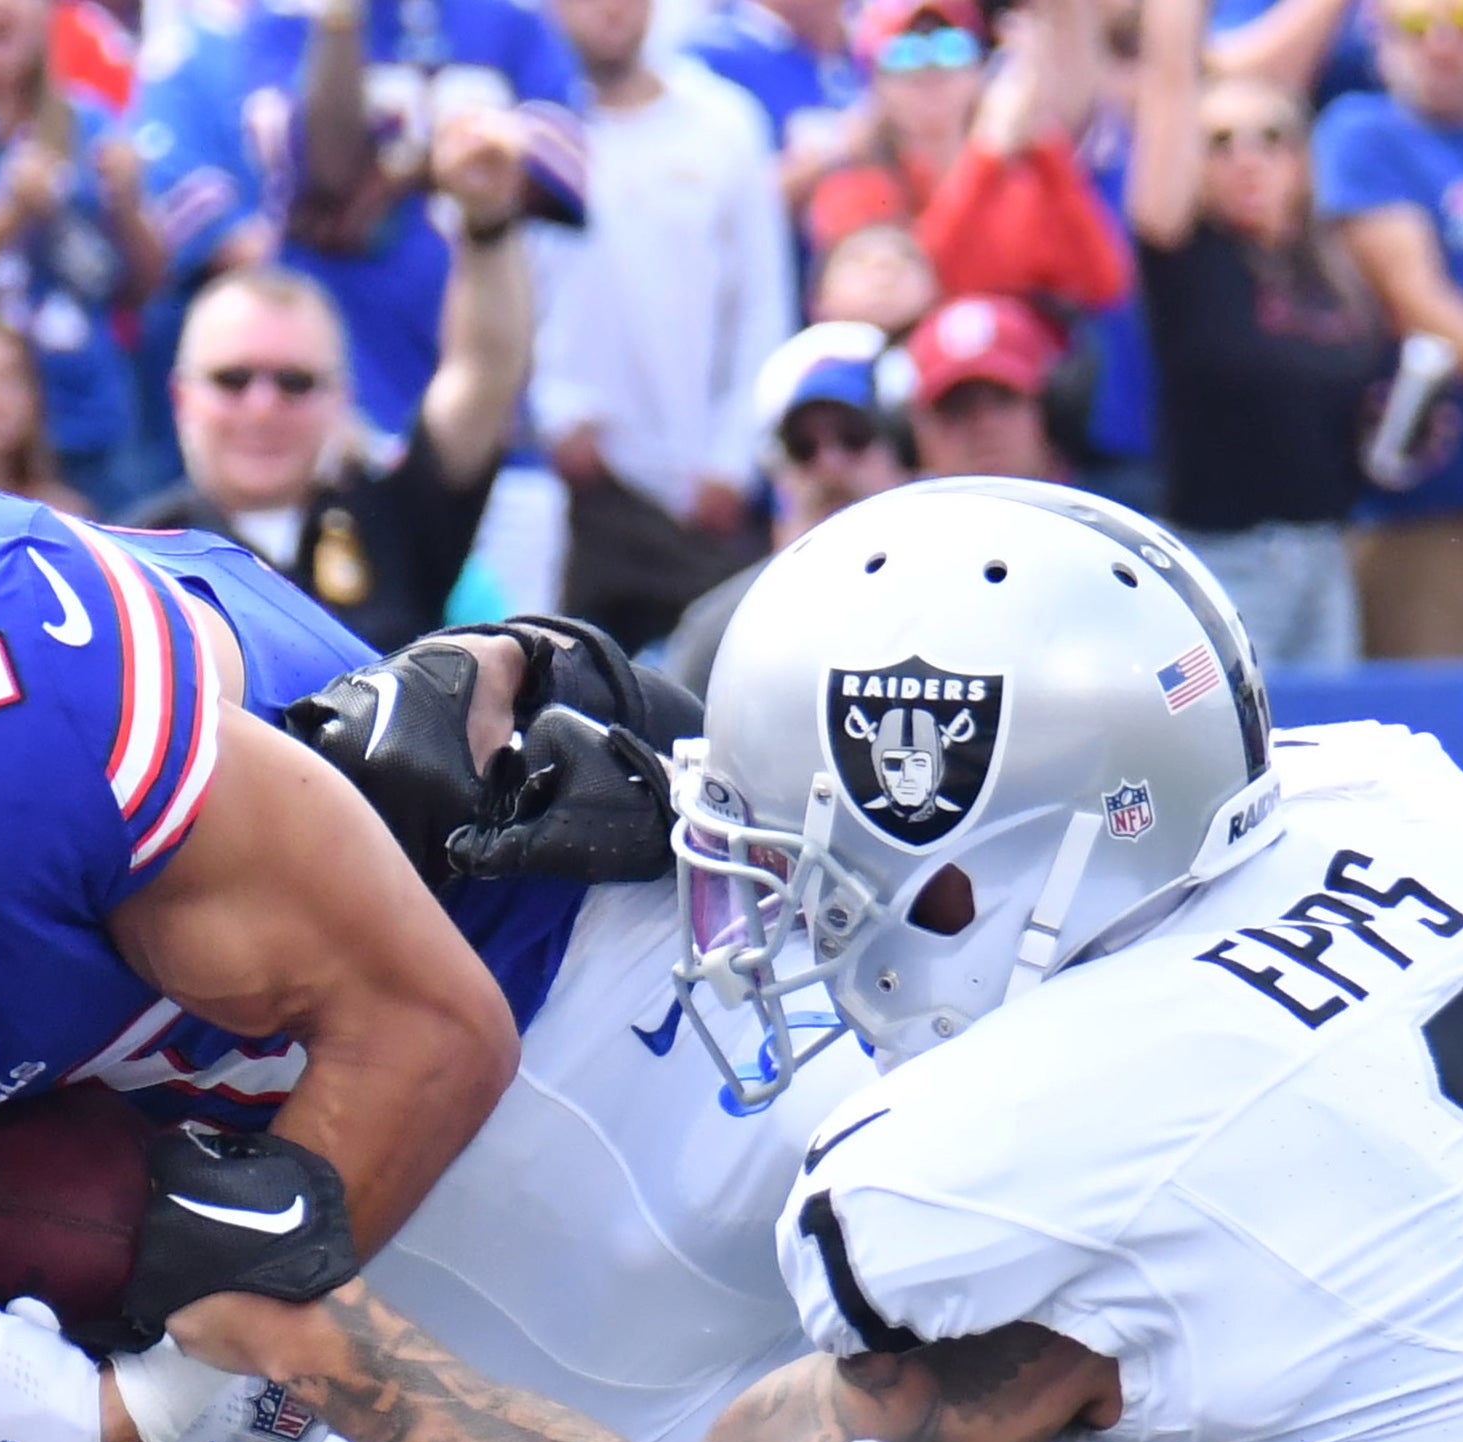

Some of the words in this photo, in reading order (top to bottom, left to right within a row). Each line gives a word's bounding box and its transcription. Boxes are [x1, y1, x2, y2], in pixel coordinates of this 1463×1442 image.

[842, 674, 986, 702] RAIDERS
[1112, 805, 1148, 832] NFL
[798, 1187, 928, 1354] 1
